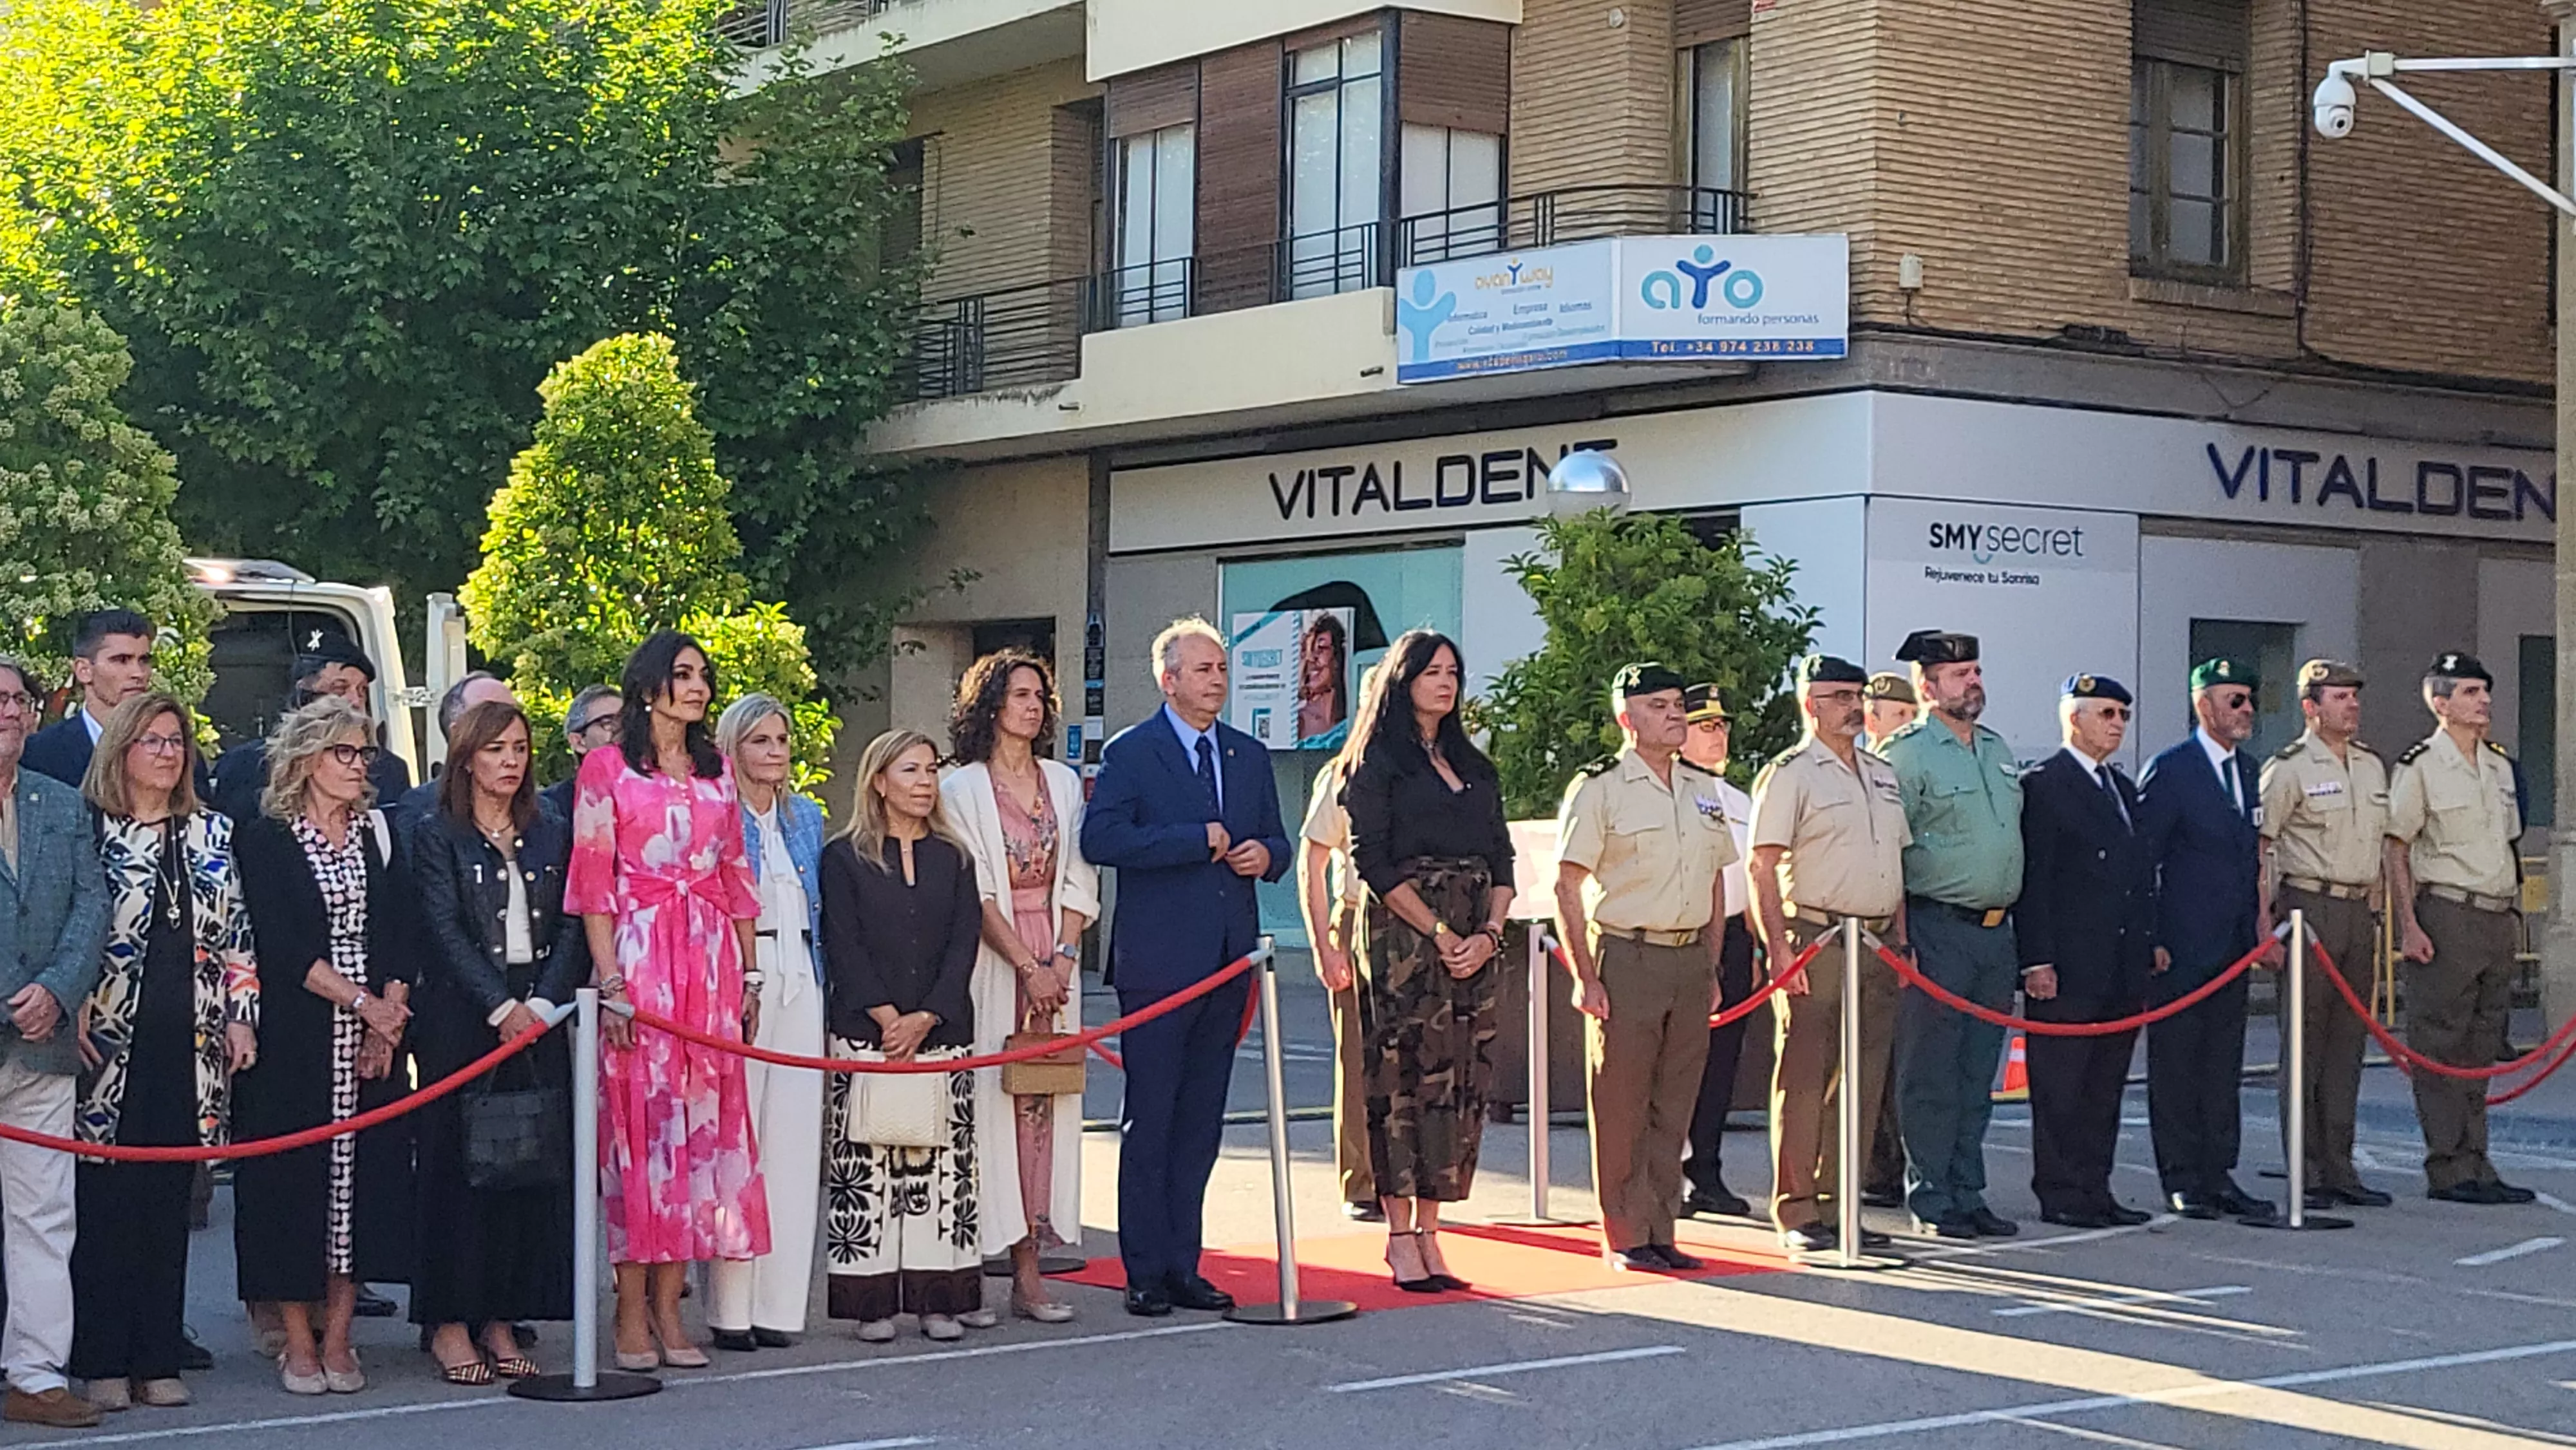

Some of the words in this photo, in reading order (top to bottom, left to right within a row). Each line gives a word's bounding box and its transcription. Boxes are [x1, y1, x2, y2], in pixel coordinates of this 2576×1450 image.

[1697, 314, 1760, 325] formando
[1762, 315, 1819, 327] personas
[1687, 341, 1714, 353] +34
[1719, 341, 1747, 353] 974
[1269, 438, 1618, 520] VITALDEN
[1924, 565, 1985, 583] Rejuvenece
[1987, 572, 2000, 583] tu
[2002, 570, 2040, 585] Sonrisa
